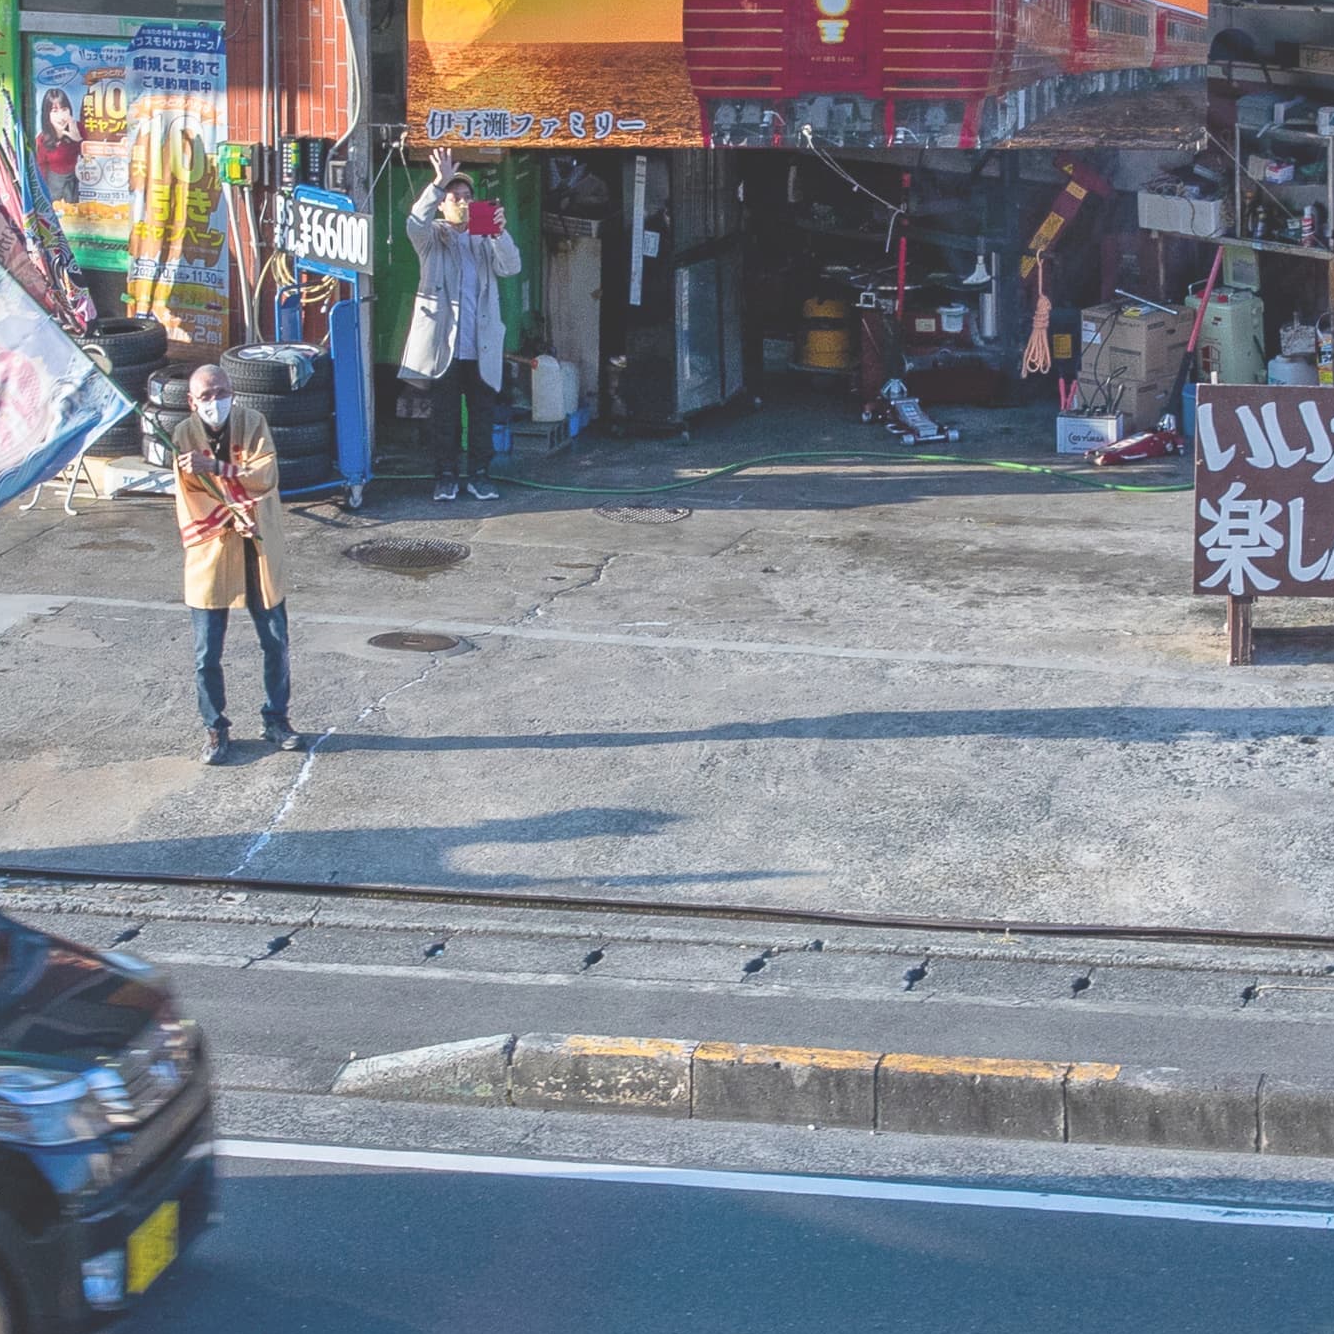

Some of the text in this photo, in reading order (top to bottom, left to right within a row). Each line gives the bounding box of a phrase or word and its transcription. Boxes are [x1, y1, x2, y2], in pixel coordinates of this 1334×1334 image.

[133, 55, 220, 77] 新規ご契約で
[142, 75, 212, 93] ご契約期間中
[427, 107, 647, 140] 伊予灘ファミリー
[134, 221, 224, 247] キャンペーン
[298, 204, 369, 266] ¥66000
